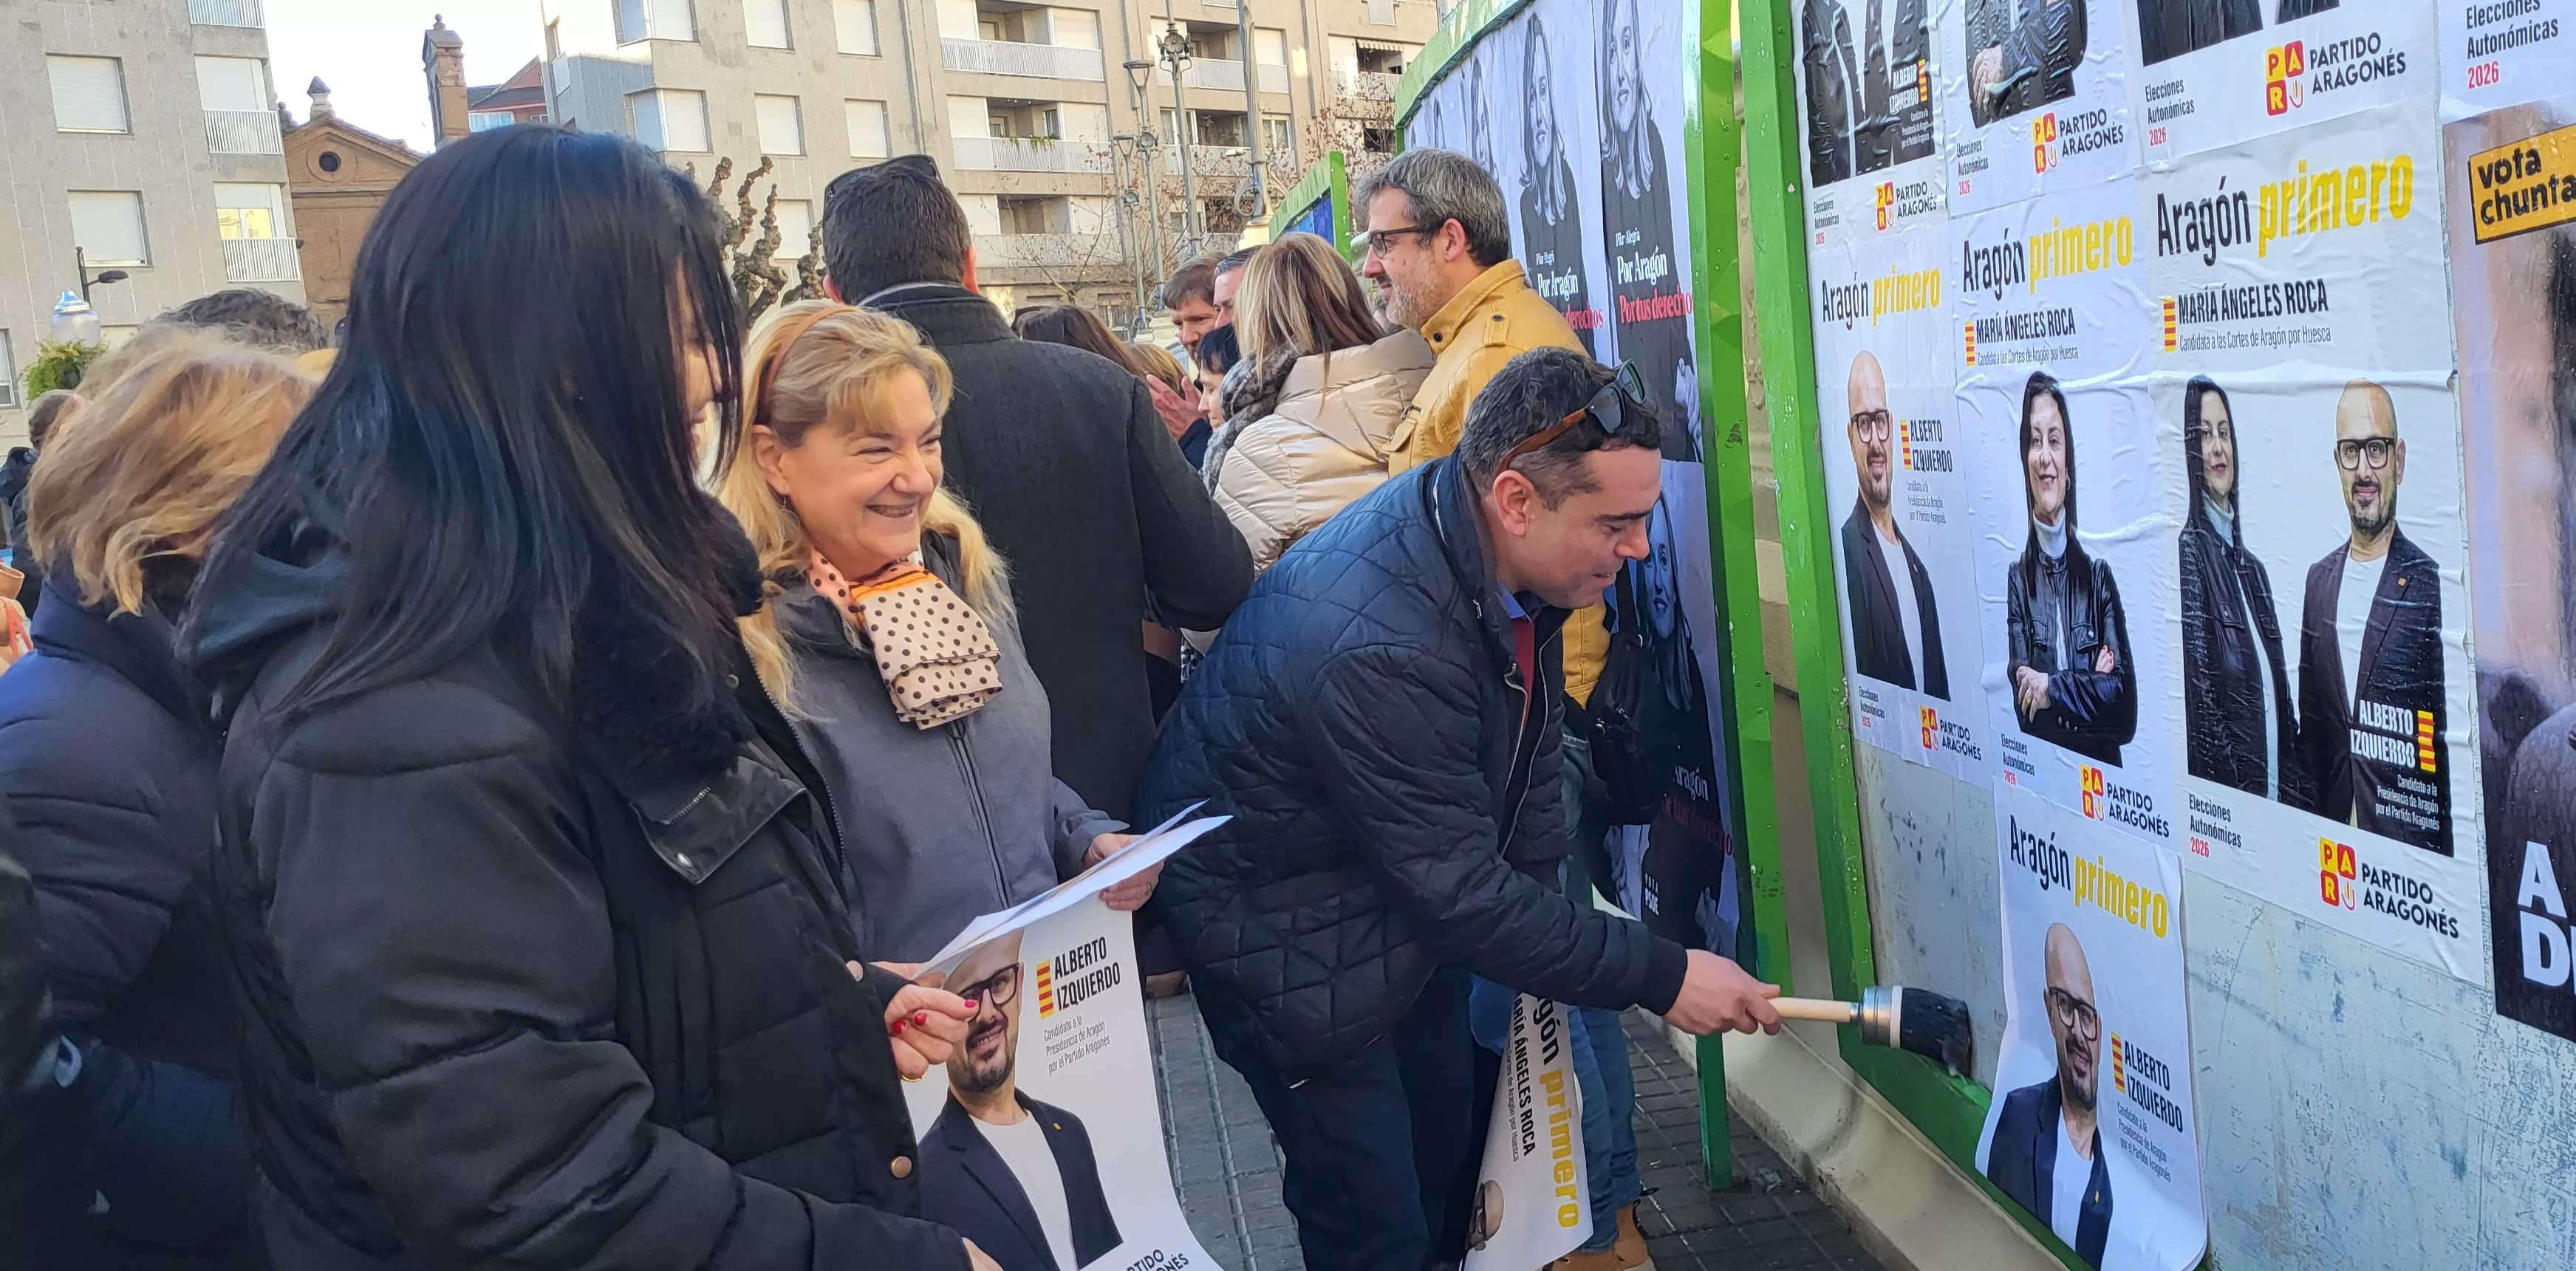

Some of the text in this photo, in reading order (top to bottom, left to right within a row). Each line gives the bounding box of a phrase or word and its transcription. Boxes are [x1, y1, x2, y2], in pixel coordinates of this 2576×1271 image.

[2466, 0, 2541, 30] Elecciones
[2310, 32, 2381, 70] PARTIDO
[2467, 18, 2558, 59] Autonómicas
[1893, 64, 1917, 89] ALBERTO
[2312, 49, 2406, 95] ARAGONÉS
[2468, 61, 2499, 89] 2026
[1890, 86, 1919, 115] IZQUIERDO
[2145, 79, 2184, 103] Elecciones
[2060, 109, 2107, 137] PARTIDO
[2148, 98, 2195, 125] Autonómicas
[1957, 140, 1982, 158] Elecciones
[2062, 122, 2124, 157] ARAGONÉS
[2150, 127, 2167, 146] 2026
[1958, 156, 1989, 177] Autonómicas
[2477, 147, 2541, 189] vota
[1896, 181, 1927, 202] PARTIDO
[1959, 180, 1970, 195] 2026
[1814, 199, 1834, 213] Elecciones
[1898, 193, 1937, 219] ARAGONÉS
[2157, 154, 2413, 266] Aragón primero
[1815, 213, 1839, 229] Autonómicas
[1617, 246, 1667, 285] Por Aragón
[1964, 216, 2133, 301] Aragón primero
[1537, 267, 1578, 301] Por Aragón
[1822, 265, 1941, 330] Aragón primero
[1619, 295, 1634, 323] Por
[1636, 295, 1650, 321] tus
[2179, 278, 2329, 324] MARÍA ÁNGELES ROCA
[1976, 307, 2076, 344] MARÍA ÁNGELES ROCA
[2179, 324, 2331, 351] Candidata a las Cortes de Aragón por Huesca
[2008, 349, 2026, 364] Cortes
[2026, 347, 2032, 362] de
[2033, 345, 2049, 365] Aragón
[2050, 349, 2059, 365] por
[2060, 346, 2079, 361] Huesca
[1910, 419, 1942, 442] ALBERTO
[1913, 449, 1953, 473] IZQUIERDO
[1940, 719, 1970, 742] PARTIDO
[2360, 699, 2413, 735] ALBERTO
[1942, 736, 1981, 761] ARAGONÉS
[2001, 733, 2027, 756] Elecciones
[2350, 729, 2415, 768] IZQUIERDO
[2003, 752, 2035, 776] Autonómicas
[2004, 770, 2016, 786] 2026
[2107, 782, 2152, 812] PARTIDO
[2398, 774, 2437, 796] Candidato a la
[2190, 793, 2231, 822] Elecciones
[2377, 785, 2439, 815] Presidencia de Aragón
[2109, 803, 2169, 837] ARAGONÉS
[2376, 804, 2439, 830] por el Partido Aragonés
[2190, 815, 2241, 849] Autonómicas
[2190, 837, 2210, 858] 2026
[2010, 814, 2167, 938] Aragón primero
[2362, 863, 2433, 904] PARTIDO
[1644, 887, 1659, 916] PSOE
[2364, 888, 2459, 939] ARAGONÉS
[1055, 936, 1107, 981] ALBERTO
[2520, 911, 2576, 996] D
[1057, 962, 1120, 1011] IZQUIERDO
[1044, 1015, 1082, 1041] Candidato a la
[1046, 1020, 1104, 1058] Presidencia de Aragón
[1048, 1035, 1110, 1077] por el Partido Aragonés
[2125, 1041, 2170, 1092] ALBERTO
[1514, 1037, 1532, 1109] ÁNGELES
[1533, 997, 1579, 1228] gón primero
[2117, 1101, 2139, 1126] Candidato
[2127, 1073, 2183, 1133] IZQUIERDO
[1520, 1108, 1536, 1157] ROCA
[2150, 1141, 2167, 1162] Aragón
